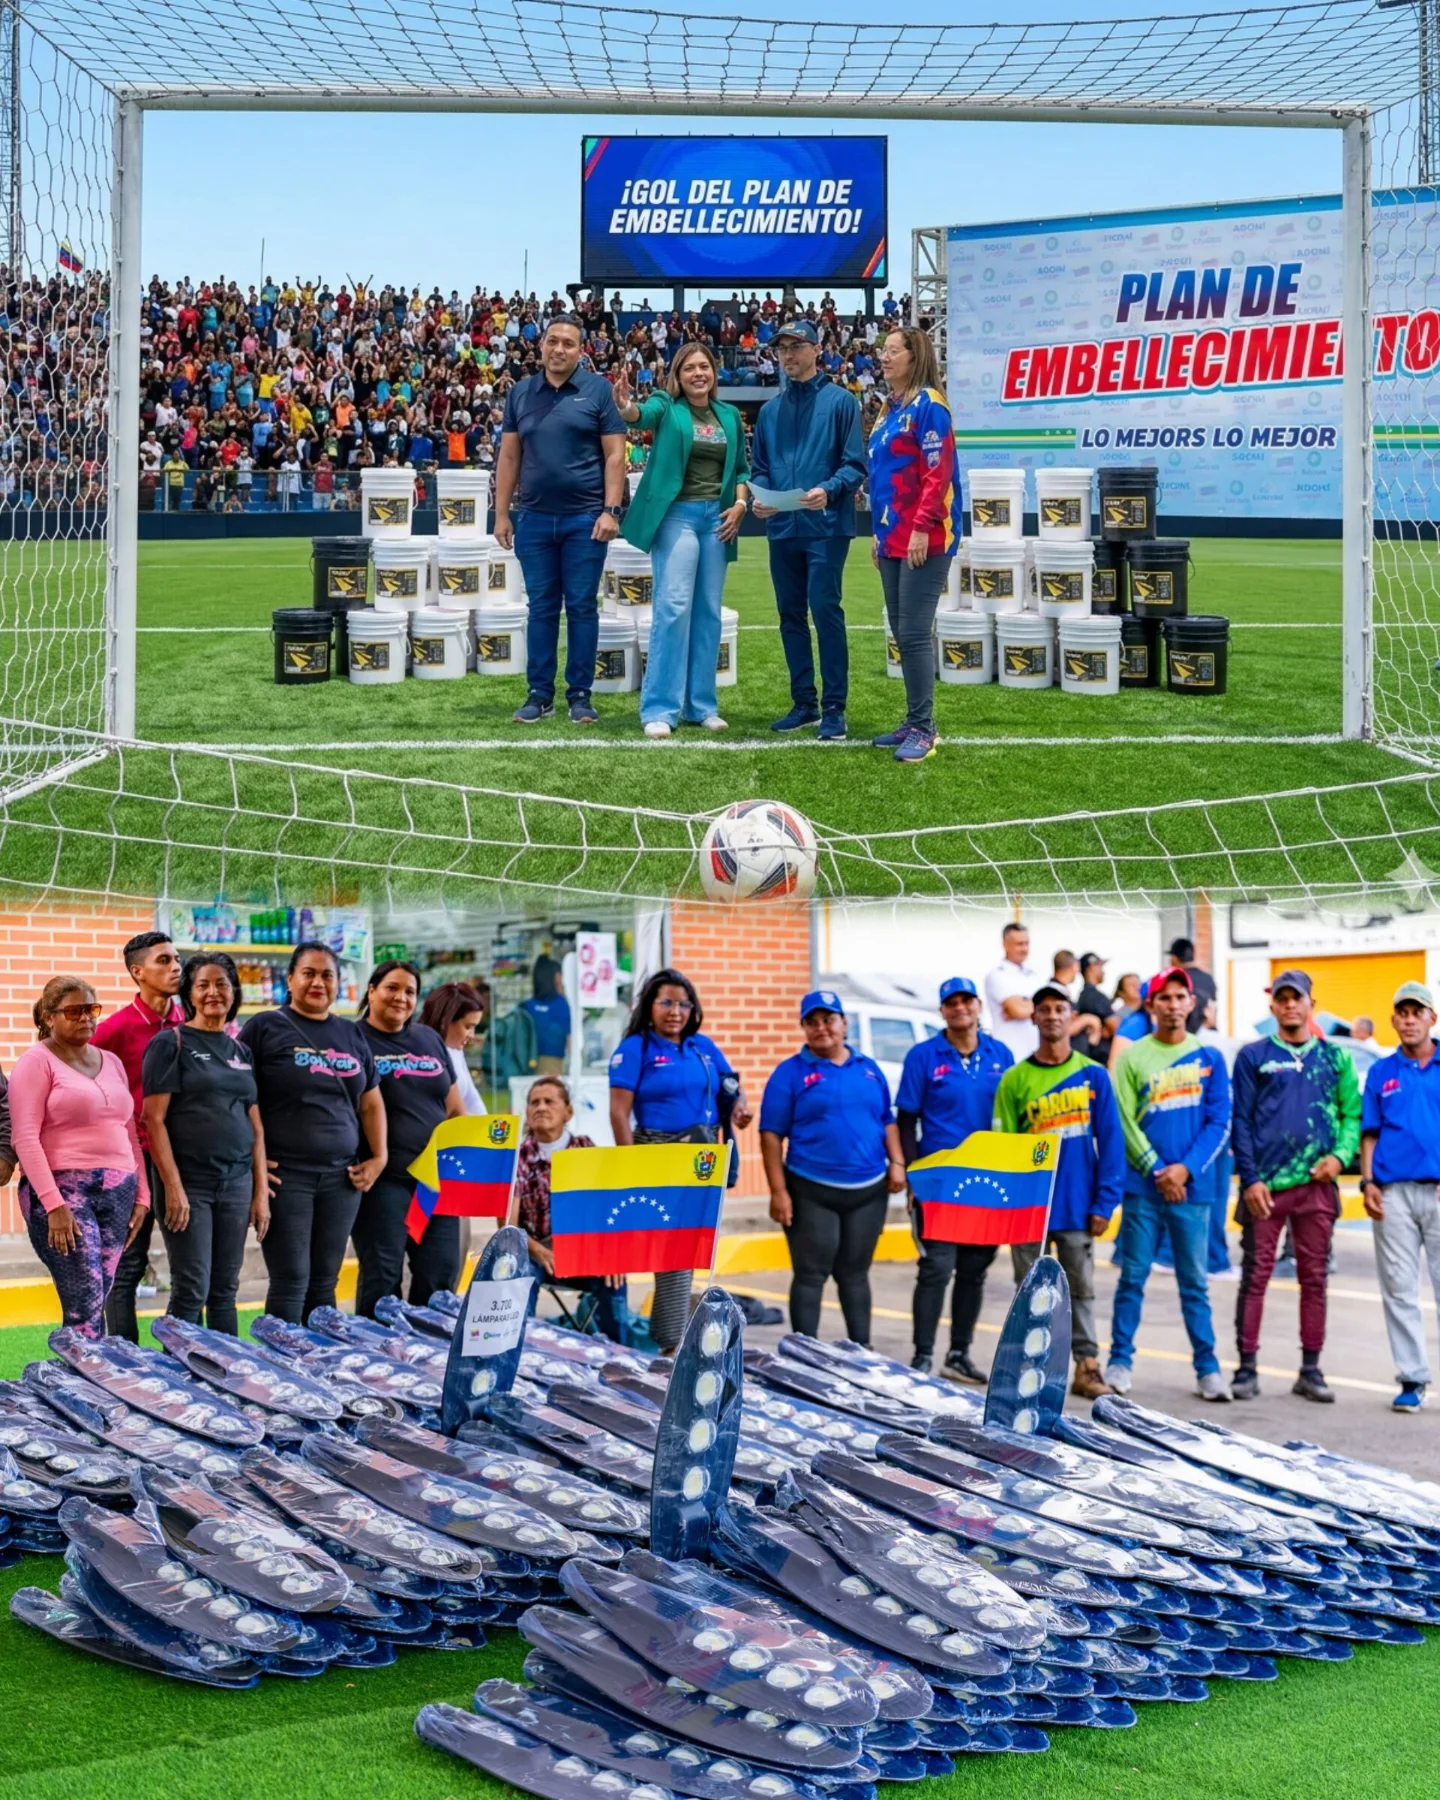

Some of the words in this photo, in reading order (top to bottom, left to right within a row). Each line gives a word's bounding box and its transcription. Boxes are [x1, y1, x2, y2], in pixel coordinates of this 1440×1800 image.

[621, 179, 680, 205] ¡GOL
[687, 179, 735, 205] DEL
[741, 179, 811, 205] PLAN
[816, 179, 853, 205] DE
[608, 208, 863, 234] EMBELLECIMIENTO!
[1115, 266, 1232, 323] PLAN
[1238, 262, 1303, 318] DE
[1002, 309, 1440, 400] EMBELLECIMIETO
[1081, 428, 1110, 448] LO
[1115, 427, 1206, 448] MEJORS
[1212, 427, 1243, 447] LO
[1250, 426, 1337, 447] MEJOR
